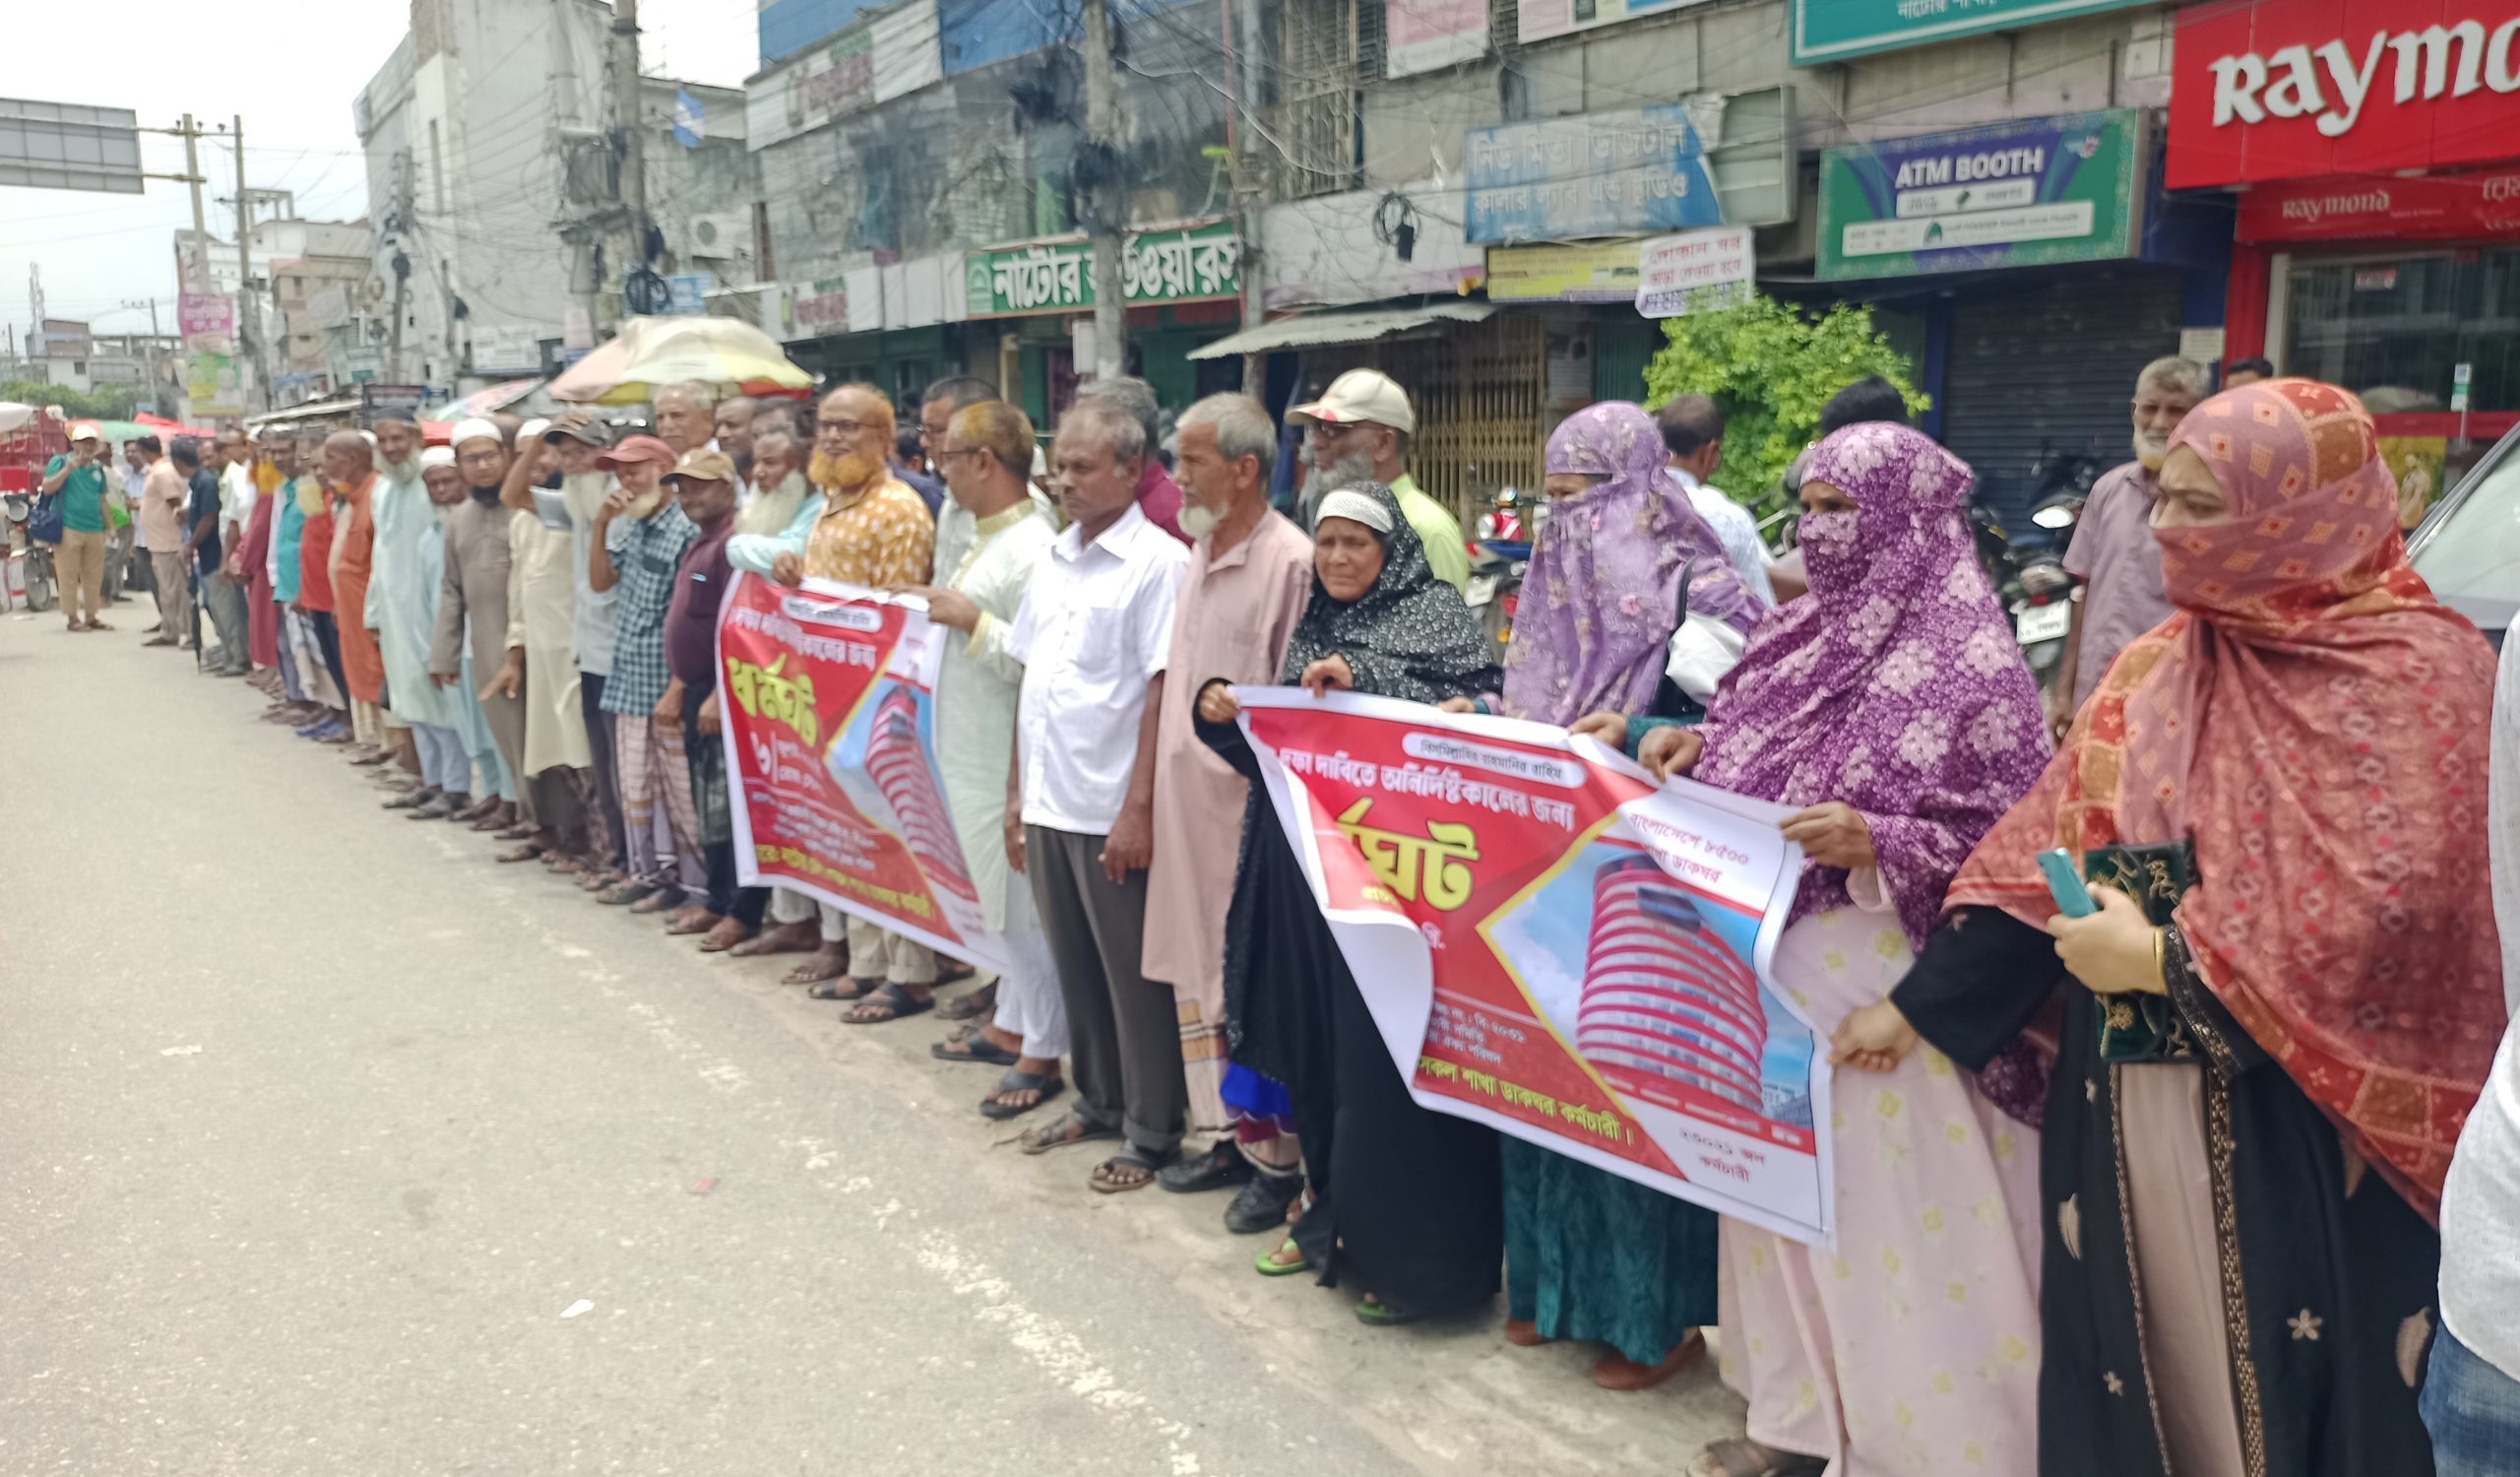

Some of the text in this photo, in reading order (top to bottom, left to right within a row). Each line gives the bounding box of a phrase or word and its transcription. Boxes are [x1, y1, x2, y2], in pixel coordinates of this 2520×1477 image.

[1895, 146, 2045, 189] ATM BOOTH
[2282, 188, 2392, 223] Raymond
[991, 244, 1083, 310] নাটোর
[726, 651, 817, 748] ধর্মঘট
[1315, 748, 1377, 788] দাবিতে
[1381, 761, 1530, 817] অনির্দিষ্টকালের
[1531, 795, 1575, 832] জন্য
[1671, 853, 1723, 883] ডাকঘর
[1704, 840, 1749, 866] ৮৫০০
[1498, 1080, 1557, 1119] ডাকঘর
[1558, 1102, 1621, 1141] কর্মচারী
